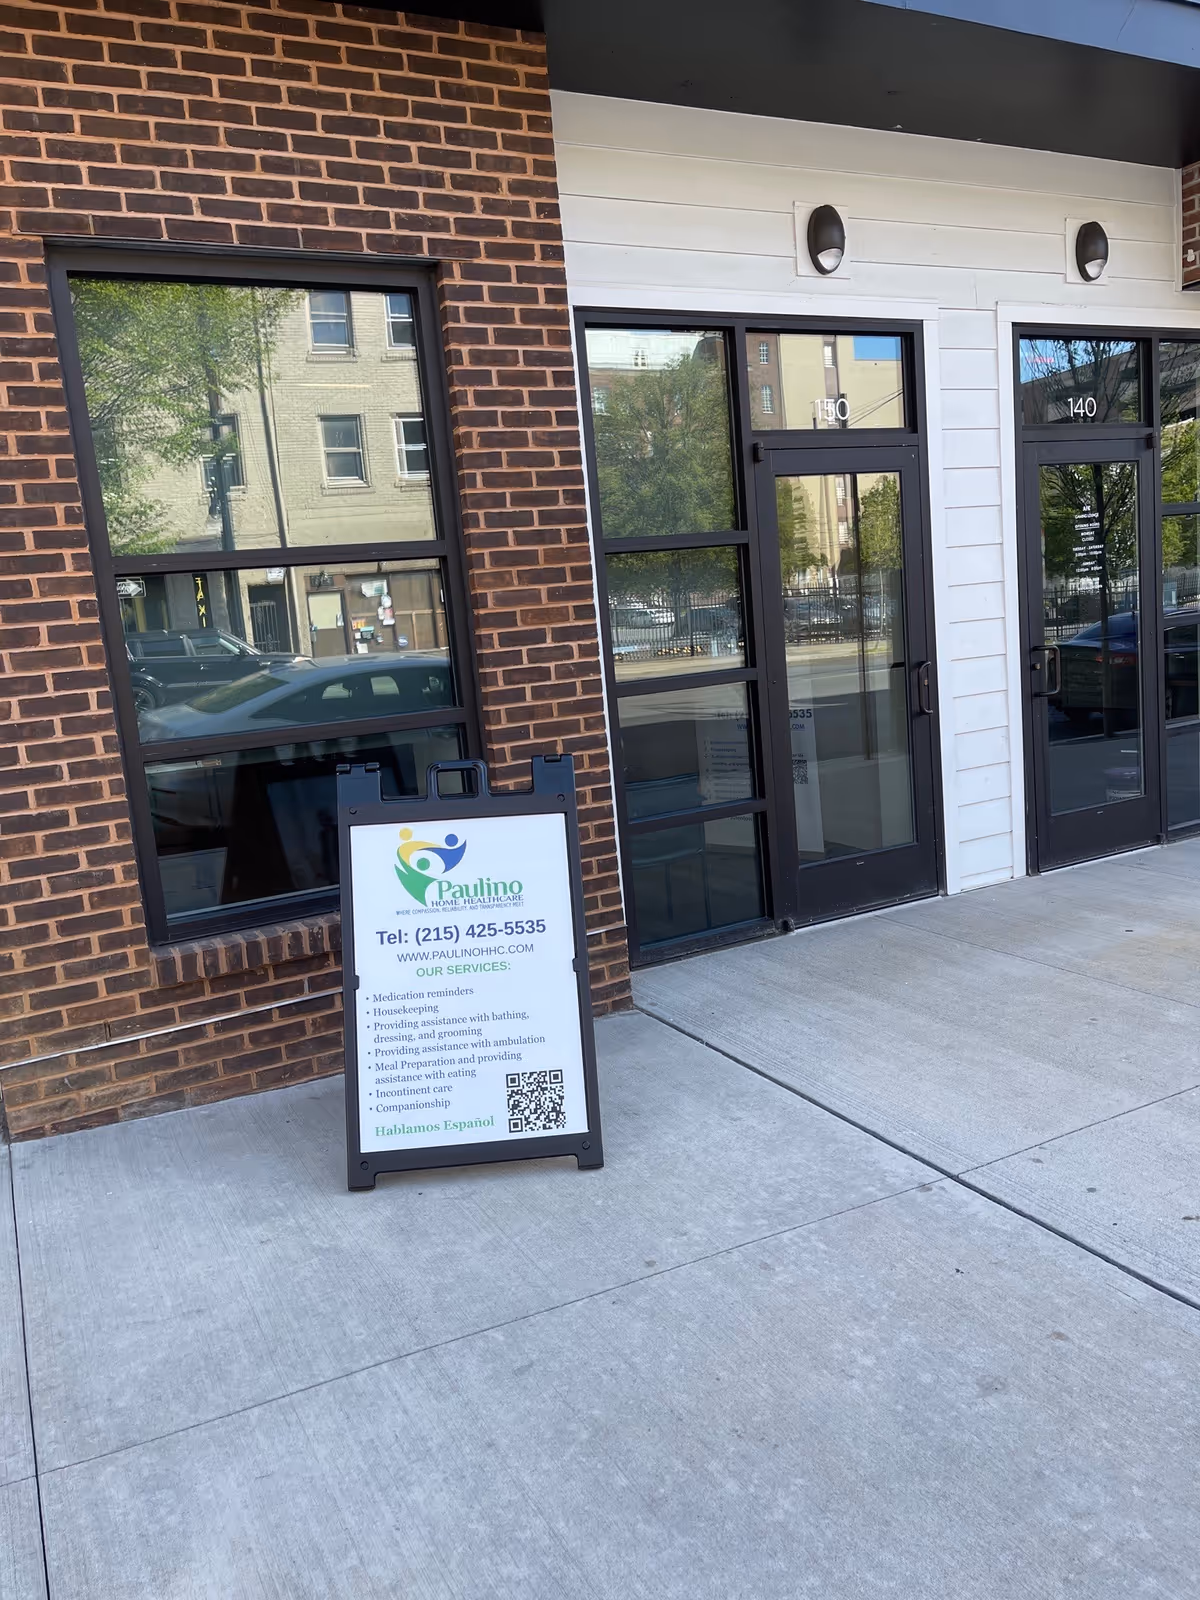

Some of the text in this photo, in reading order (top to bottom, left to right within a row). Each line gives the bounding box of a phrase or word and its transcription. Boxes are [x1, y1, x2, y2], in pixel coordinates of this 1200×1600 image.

[814, 398, 850, 421] 150
[1067, 397, 1097, 417] 140
[436, 877, 523, 900] Paulino
[431, 894, 525, 908] HOME HEALTHCARE
[376, 919, 546, 946] Tel: (215) 425-5535
[396, 943, 534, 962] WWW.PAULINOHHC.COM
[417, 962, 510, 977] OUR SERVICES:
[373, 987, 474, 1002] Medication reminders
[374, 1004, 439, 1018] Housekeeping
[374, 1011, 529, 1031] Providing assistance with bathing,
[374, 1027, 482, 1043] dressing, and grooming
[375, 1035, 545, 1057] Providing assistance with ambulation
[376, 1051, 522, 1072] Meal Preparation and providing
[375, 1068, 476, 1084] assistance with eating
[376, 1085, 453, 1098] Incontinent care
[376, 1097, 450, 1113] Companionship
[375, 1116, 494, 1136] Hablamos Español
